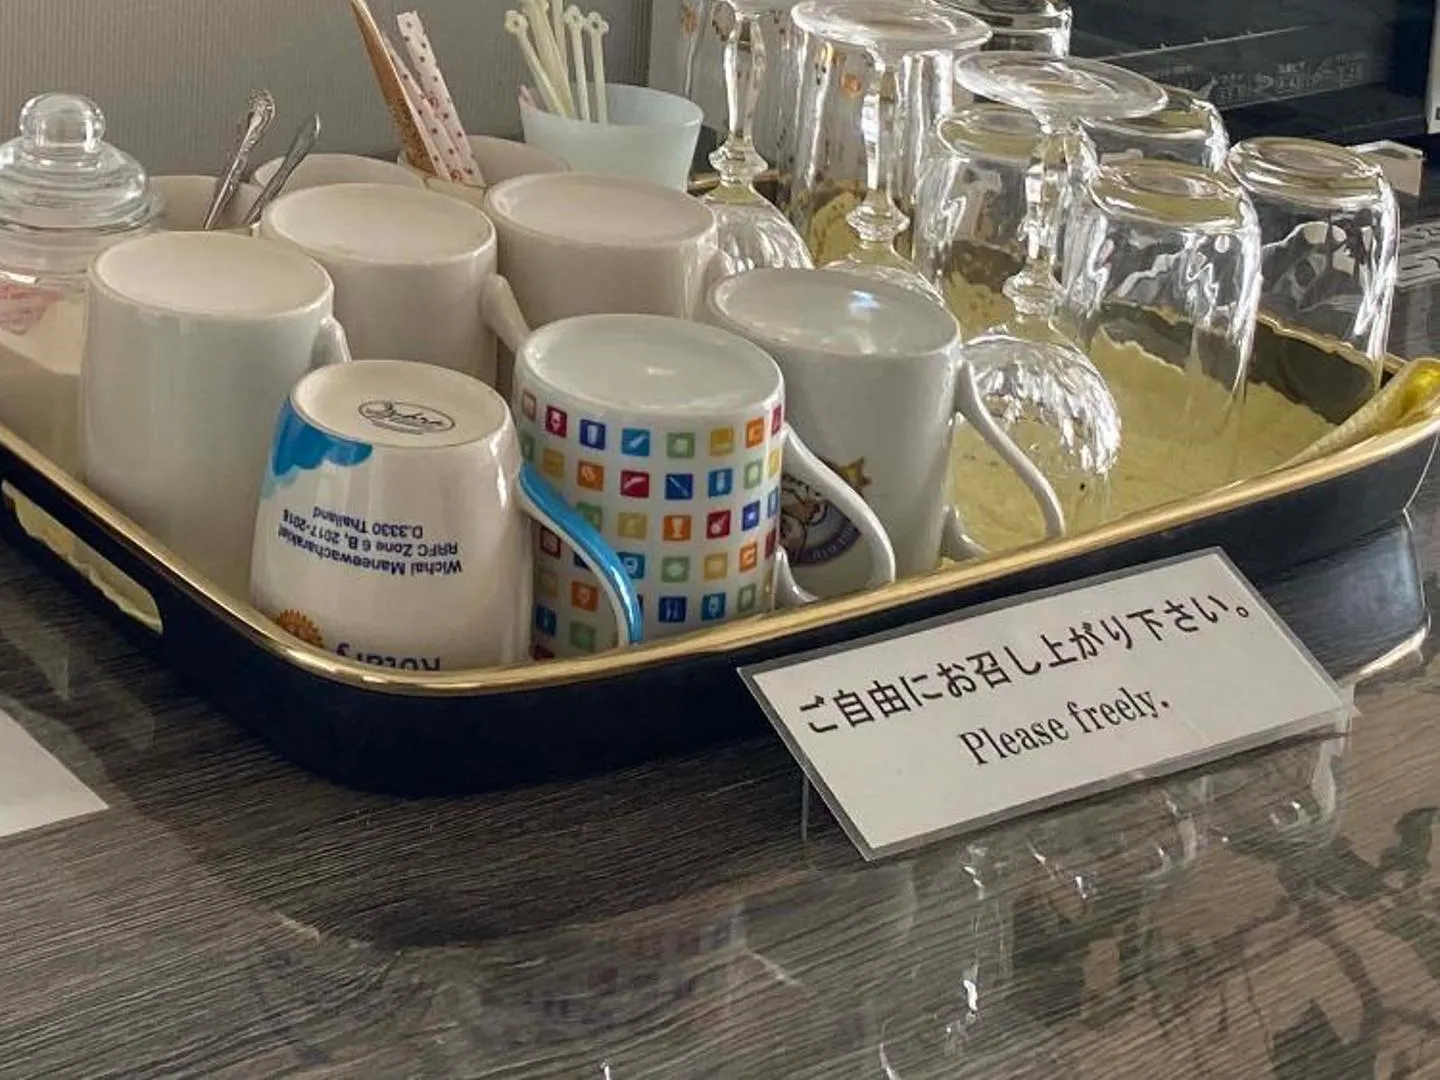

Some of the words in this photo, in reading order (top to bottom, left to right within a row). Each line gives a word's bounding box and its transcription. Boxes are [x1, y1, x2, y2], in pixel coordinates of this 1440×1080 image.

[312, 506, 367, 534] Thailand
[372, 522, 423, 539] D.3330
[376, 541, 413, 557] Zone
[336, 642, 441, 672] Roa
[799, 594, 1252, 736] ご自由にお召し上がり下さい。
[960, 712, 1070, 767] Please
[1067, 685, 1172, 738] freely.
